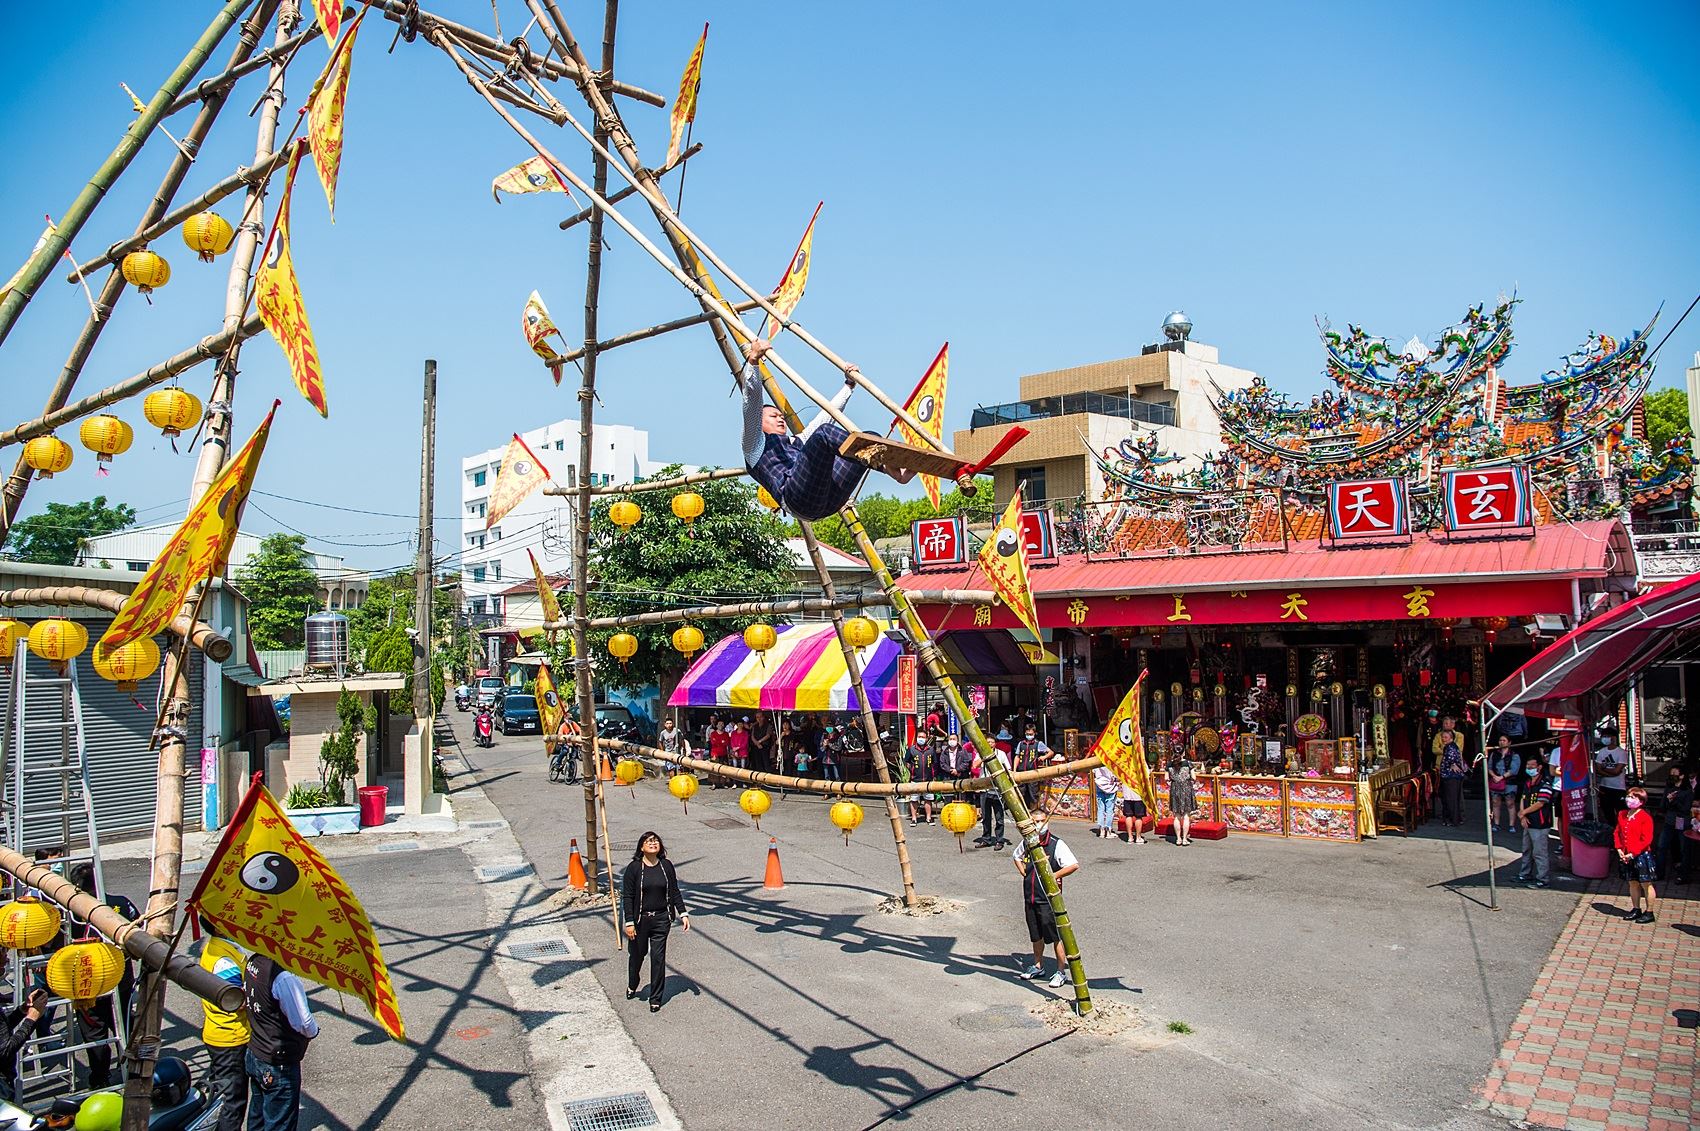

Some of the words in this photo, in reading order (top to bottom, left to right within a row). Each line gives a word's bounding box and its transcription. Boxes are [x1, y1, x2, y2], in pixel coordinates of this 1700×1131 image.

[1344, 487, 1391, 528] 天
[1459, 475, 1508, 520] 玄
[924, 523, 951, 558] 帝
[212, 841, 250, 892] 武當山
[221, 888, 244, 912] 北極
[245, 894, 361, 959] 玄天上帝
